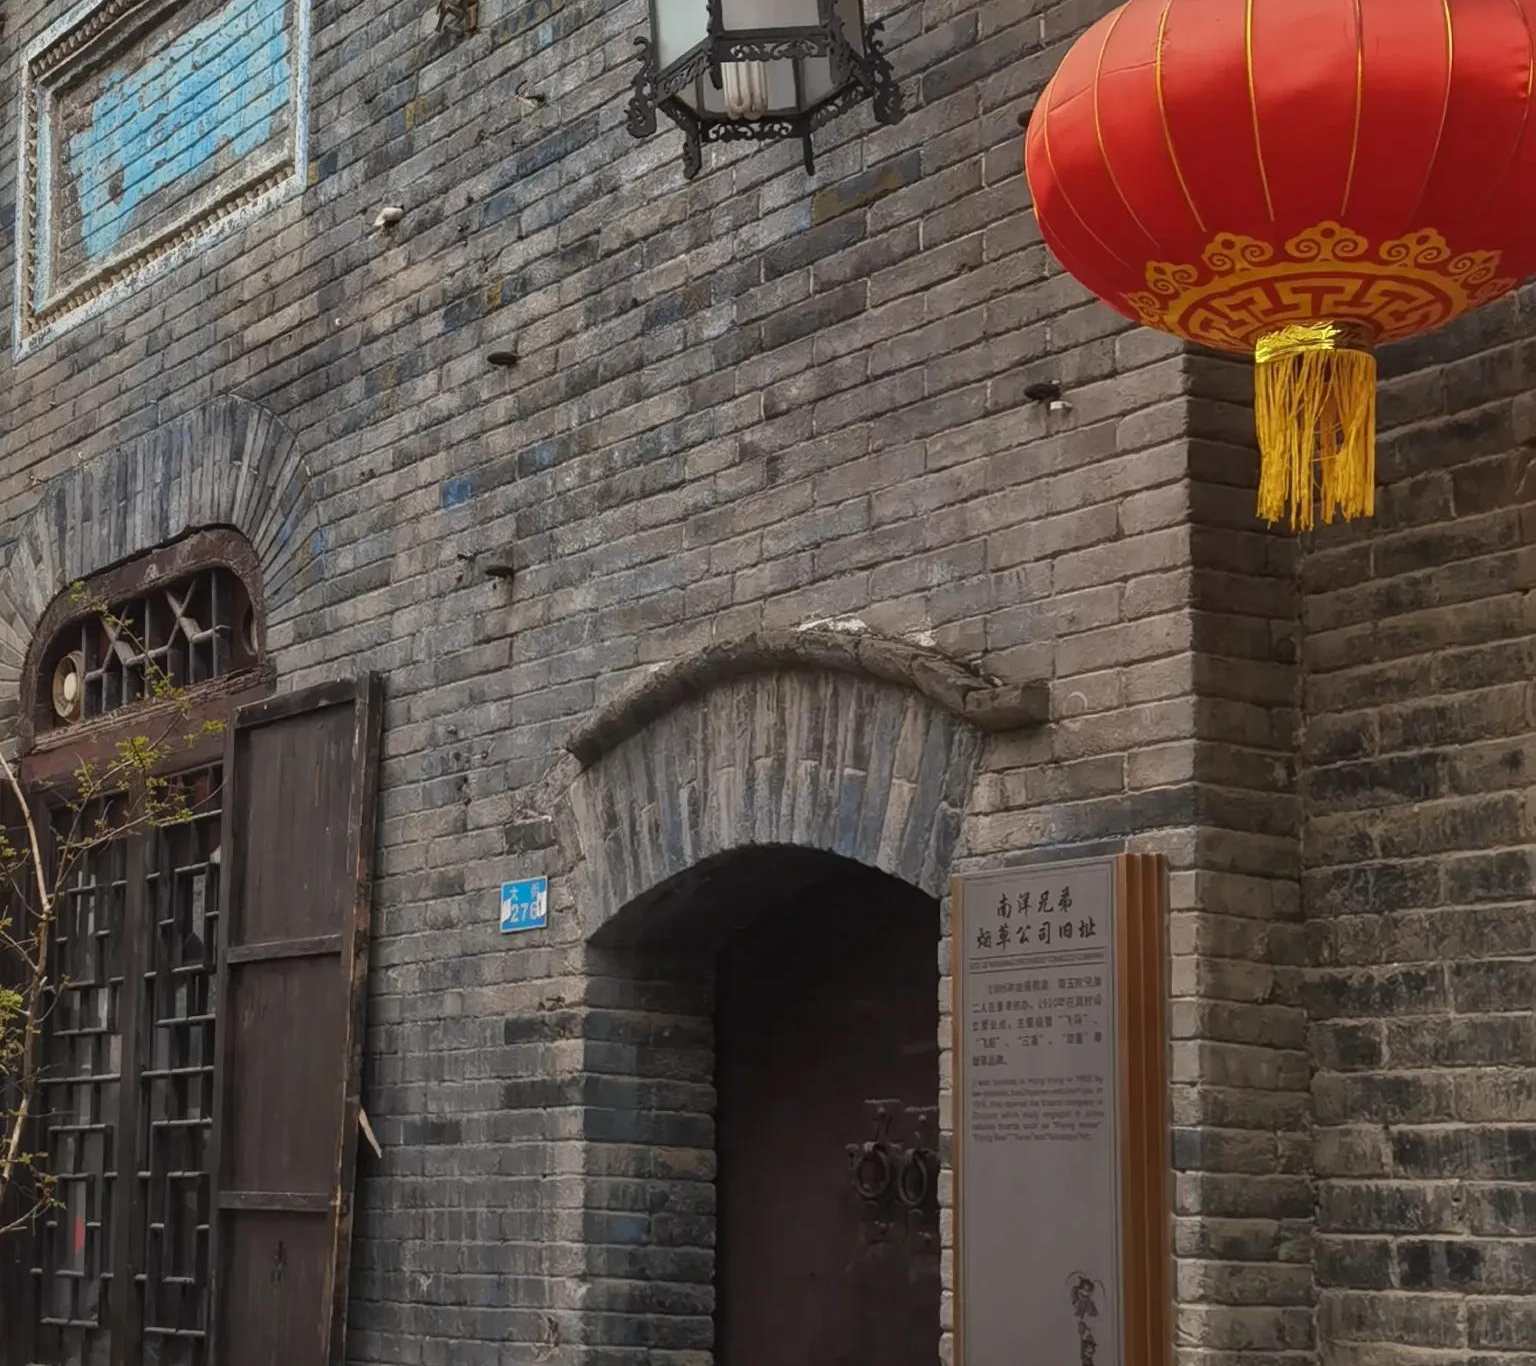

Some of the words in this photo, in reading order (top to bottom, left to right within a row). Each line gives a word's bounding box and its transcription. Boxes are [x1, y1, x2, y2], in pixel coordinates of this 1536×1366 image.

[997, 886, 1073, 918] 南洋兄弟
[976, 916, 1097, 949] 烟草公司旧址
